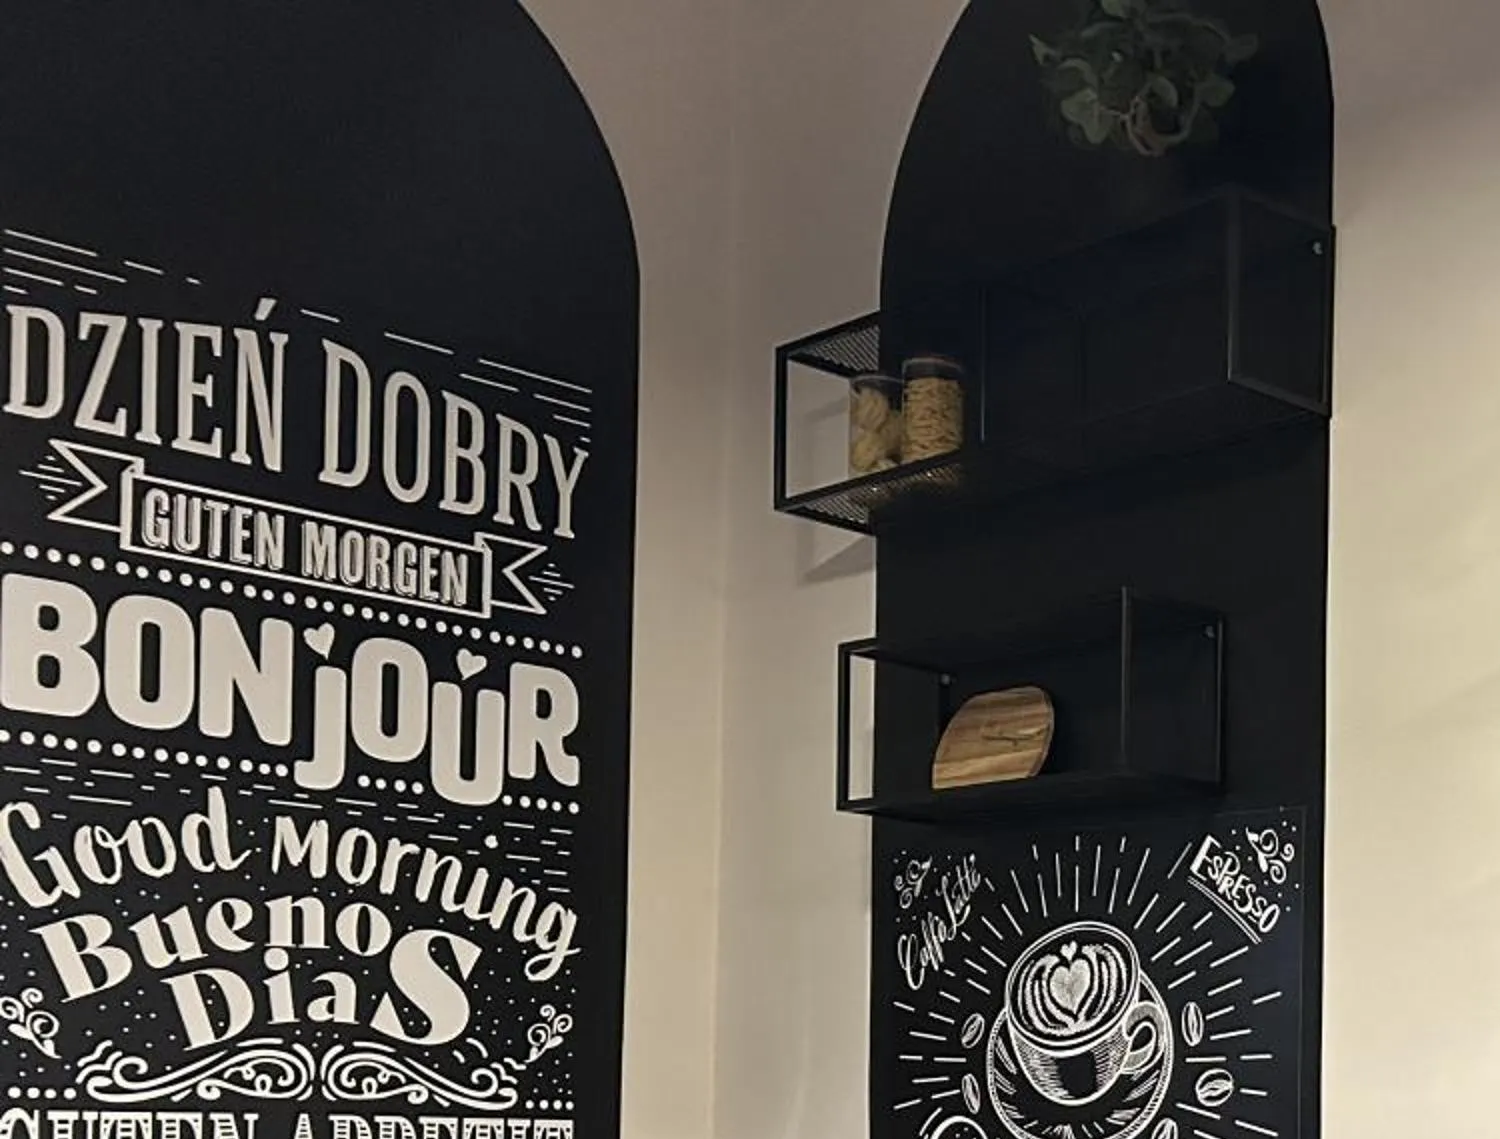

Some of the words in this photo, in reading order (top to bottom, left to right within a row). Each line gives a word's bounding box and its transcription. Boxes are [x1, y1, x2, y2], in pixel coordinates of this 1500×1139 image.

[2, 298, 290, 473] DZIEŃ
[318, 337, 589, 540] DOBRY
[141, 487, 286, 570] GUTEN
[301, 520, 469, 607] MORGEN
[0, 785, 254, 909] Good
